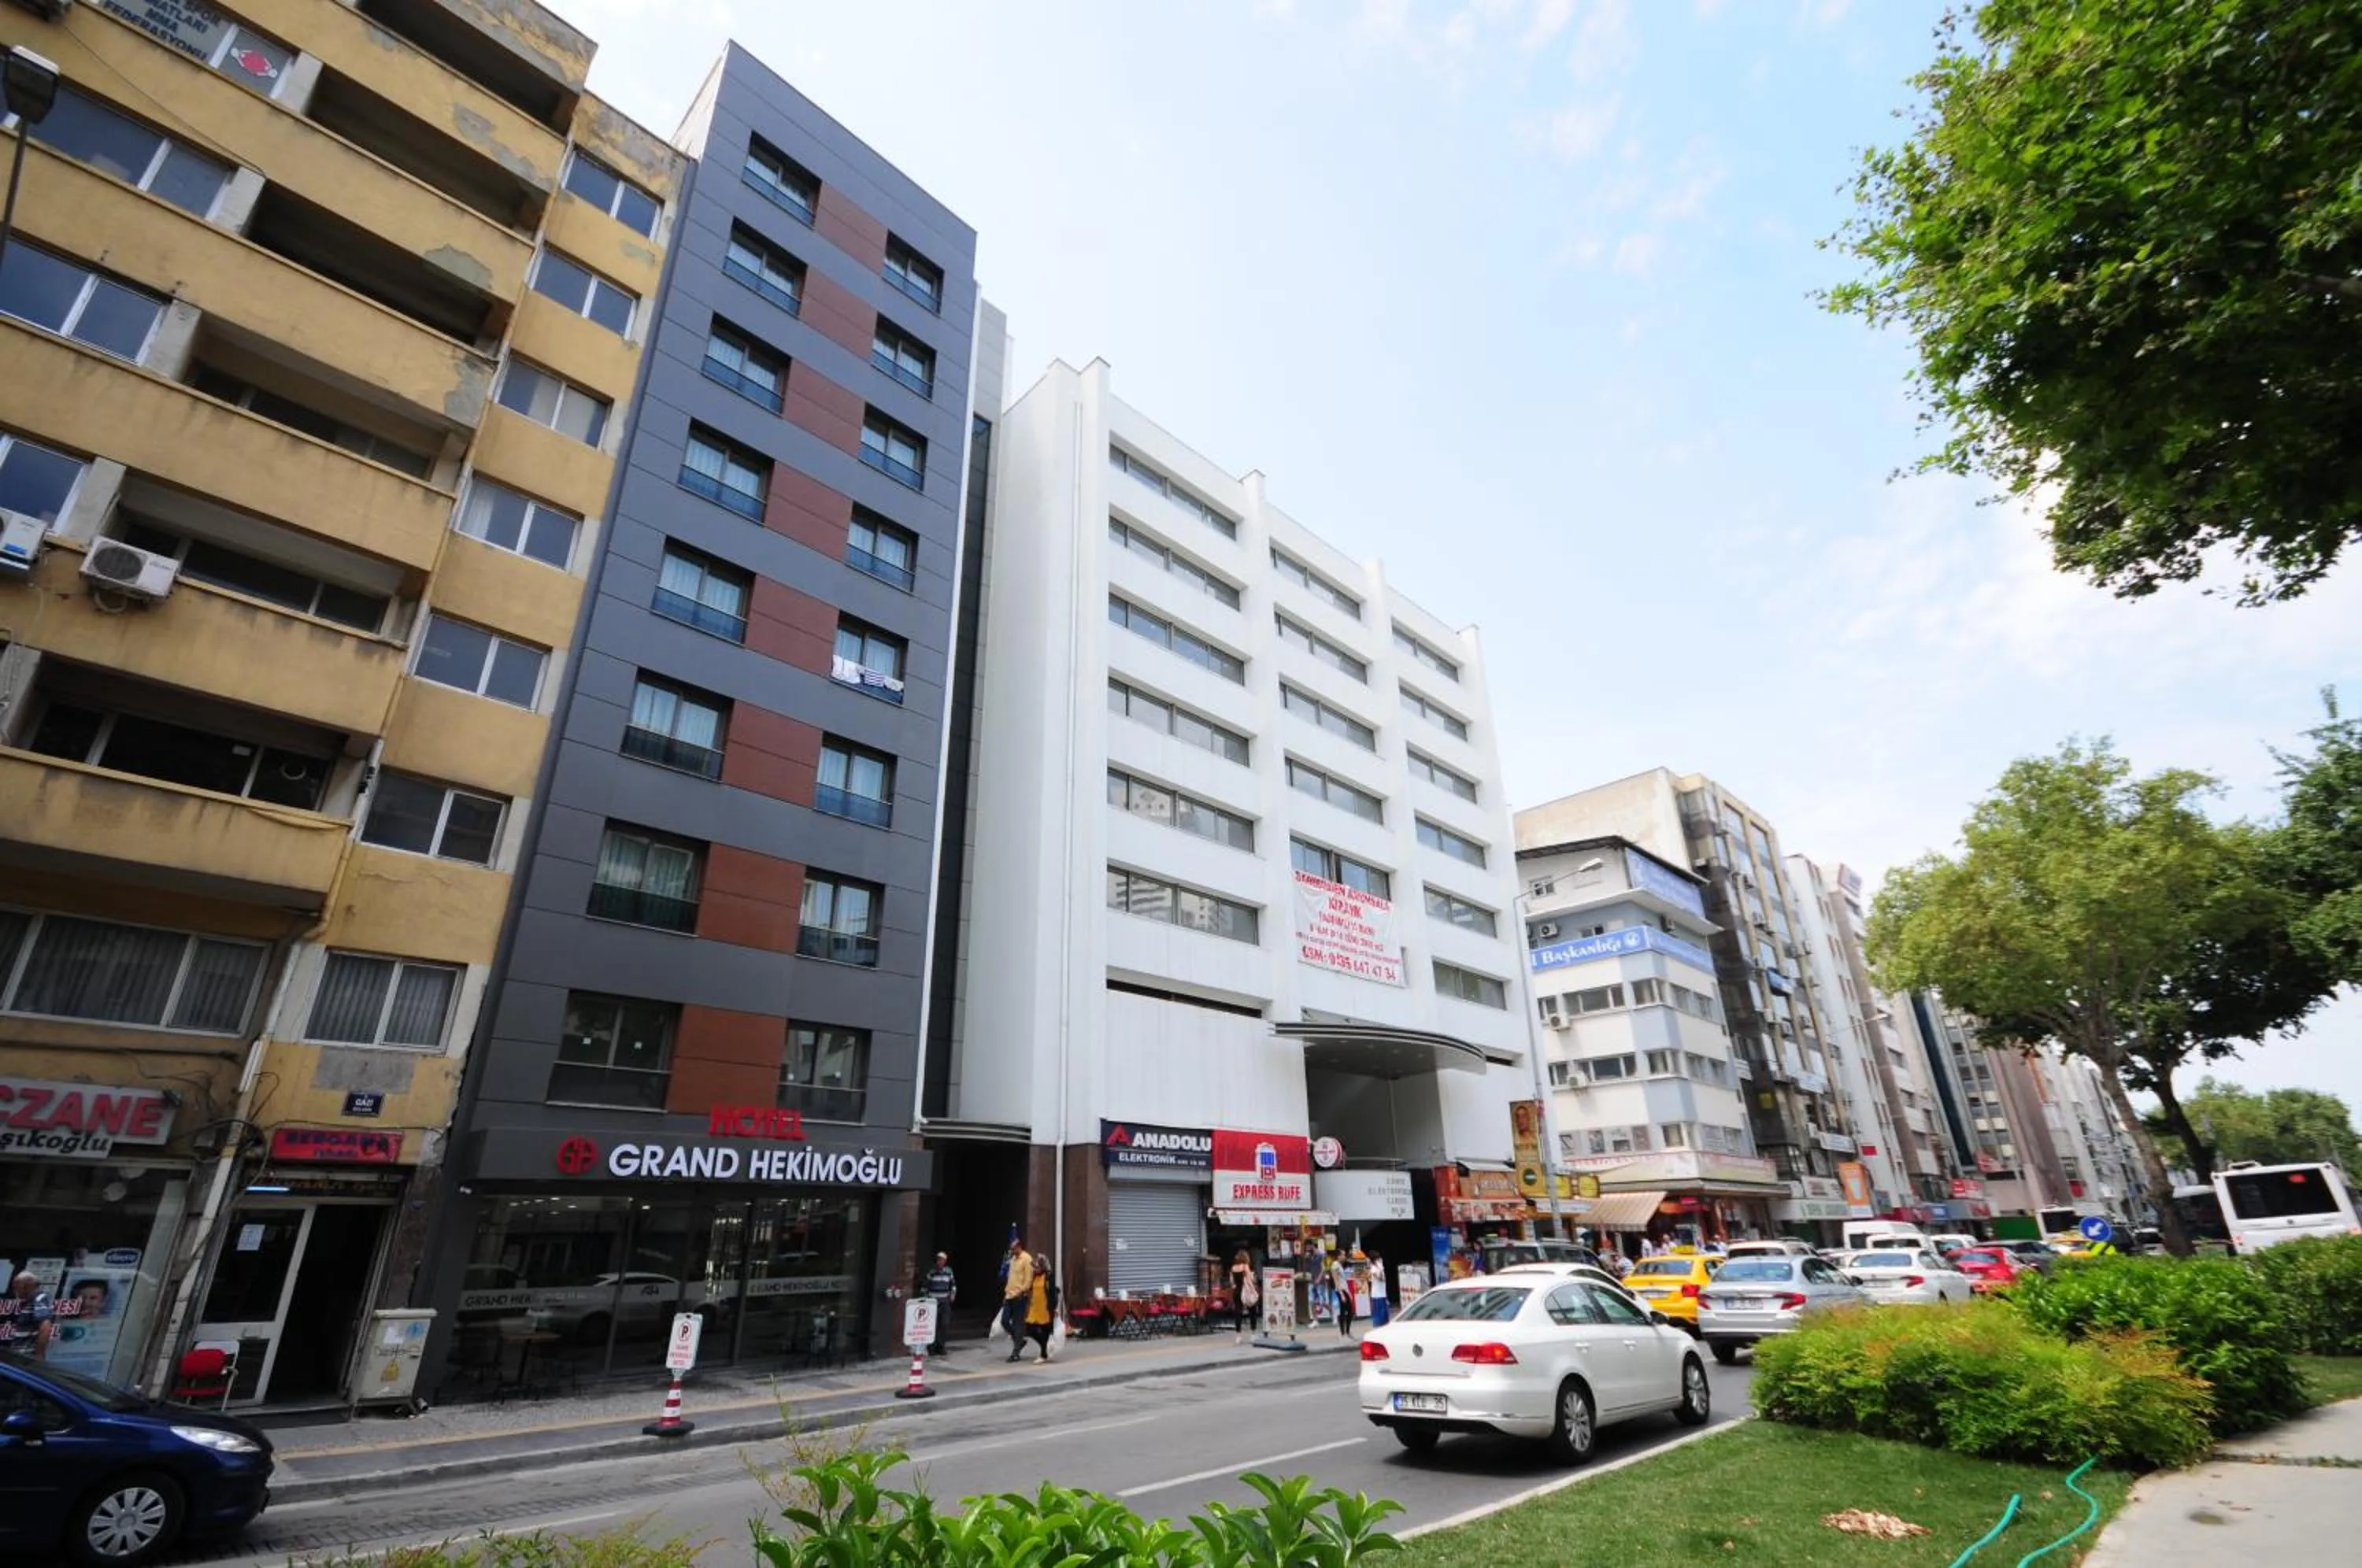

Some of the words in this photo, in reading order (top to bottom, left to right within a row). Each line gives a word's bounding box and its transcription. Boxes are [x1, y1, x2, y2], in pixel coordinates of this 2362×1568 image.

[145, 8, 179, 33] MMA
[708, 1106, 807, 1141] HOTEL
[1131, 1132, 1212, 1152] ANADOLU
[608, 1144, 740, 1178] GRAND
[748, 1146, 903, 1185] HEKİMOĞLU
[1119, 1152, 1176, 1165] ELEKTRONİK
[1232, 1184, 1275, 1200] EXPRESS
[465, 1294, 508, 1307] GRAND
